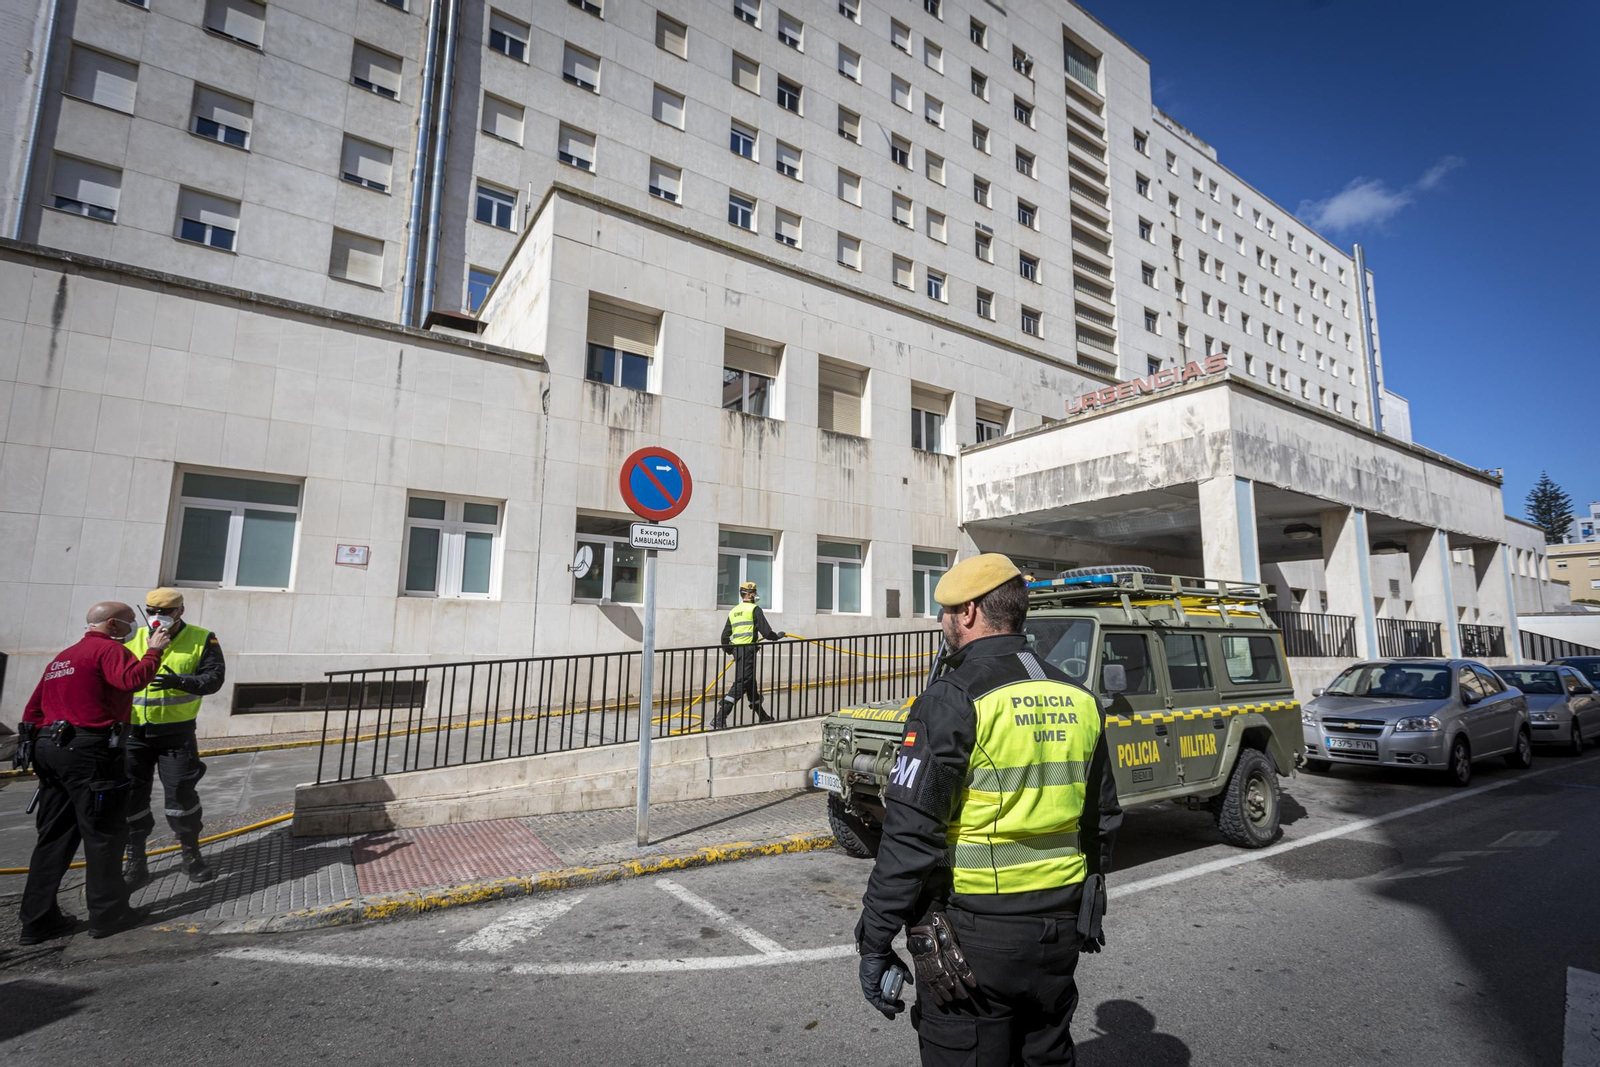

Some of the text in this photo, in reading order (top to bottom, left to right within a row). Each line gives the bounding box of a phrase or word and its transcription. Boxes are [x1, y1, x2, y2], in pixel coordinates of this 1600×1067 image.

[1065, 353, 1227, 414] URGENCIAS
[640, 528, 670, 537] Excepto
[634, 537, 675, 546] AMBULANCIAS
[1011, 695, 1074, 708] POLICIA
[1015, 712, 1079, 726] MILITAR
[1033, 730, 1066, 742] UME
[1117, 733, 1217, 768] POLICIA MILITAR
[1331, 739, 1373, 750] 7375 FVN
